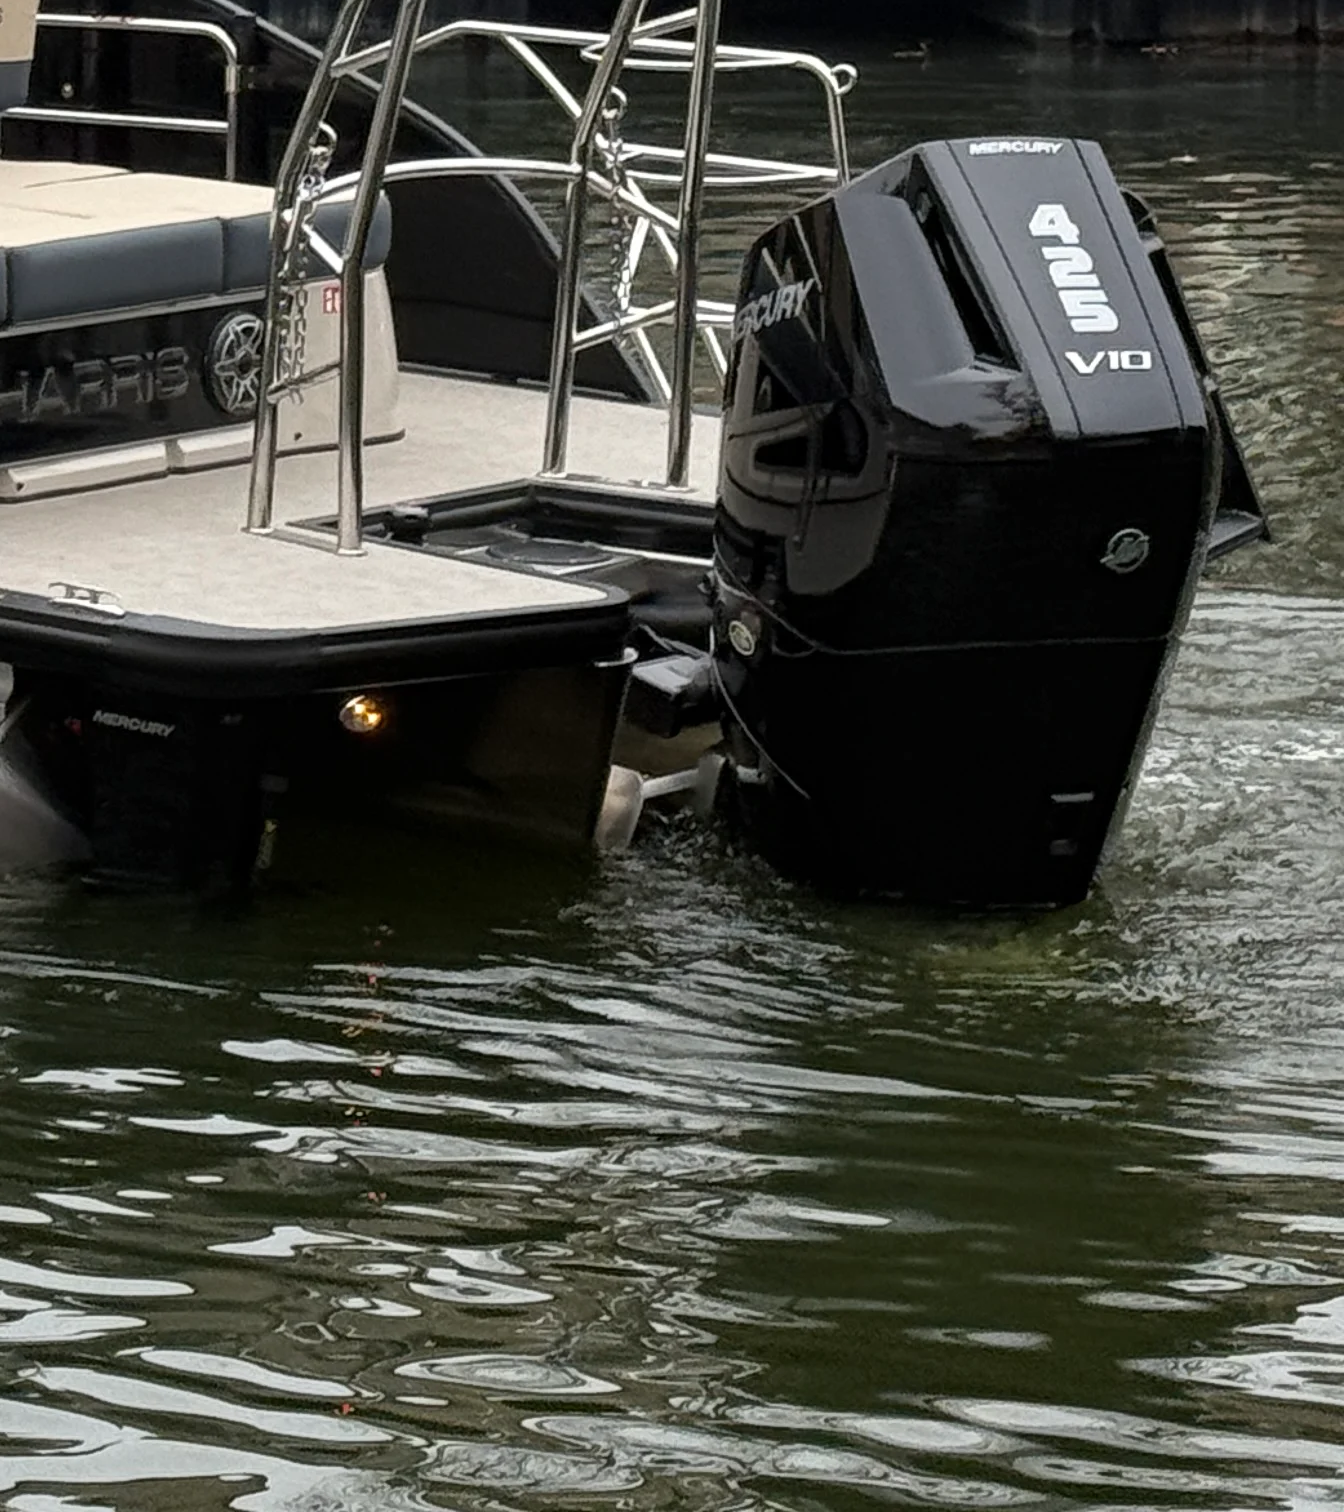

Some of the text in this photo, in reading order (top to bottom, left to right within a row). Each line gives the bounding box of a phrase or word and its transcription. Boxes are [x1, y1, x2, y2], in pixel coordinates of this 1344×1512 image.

[969, 141, 1064, 155] MERCURY
[1028, 204, 1119, 332] 425
[1065, 350, 1152, 375] V10
[92, 709, 176, 737] MERCURY
